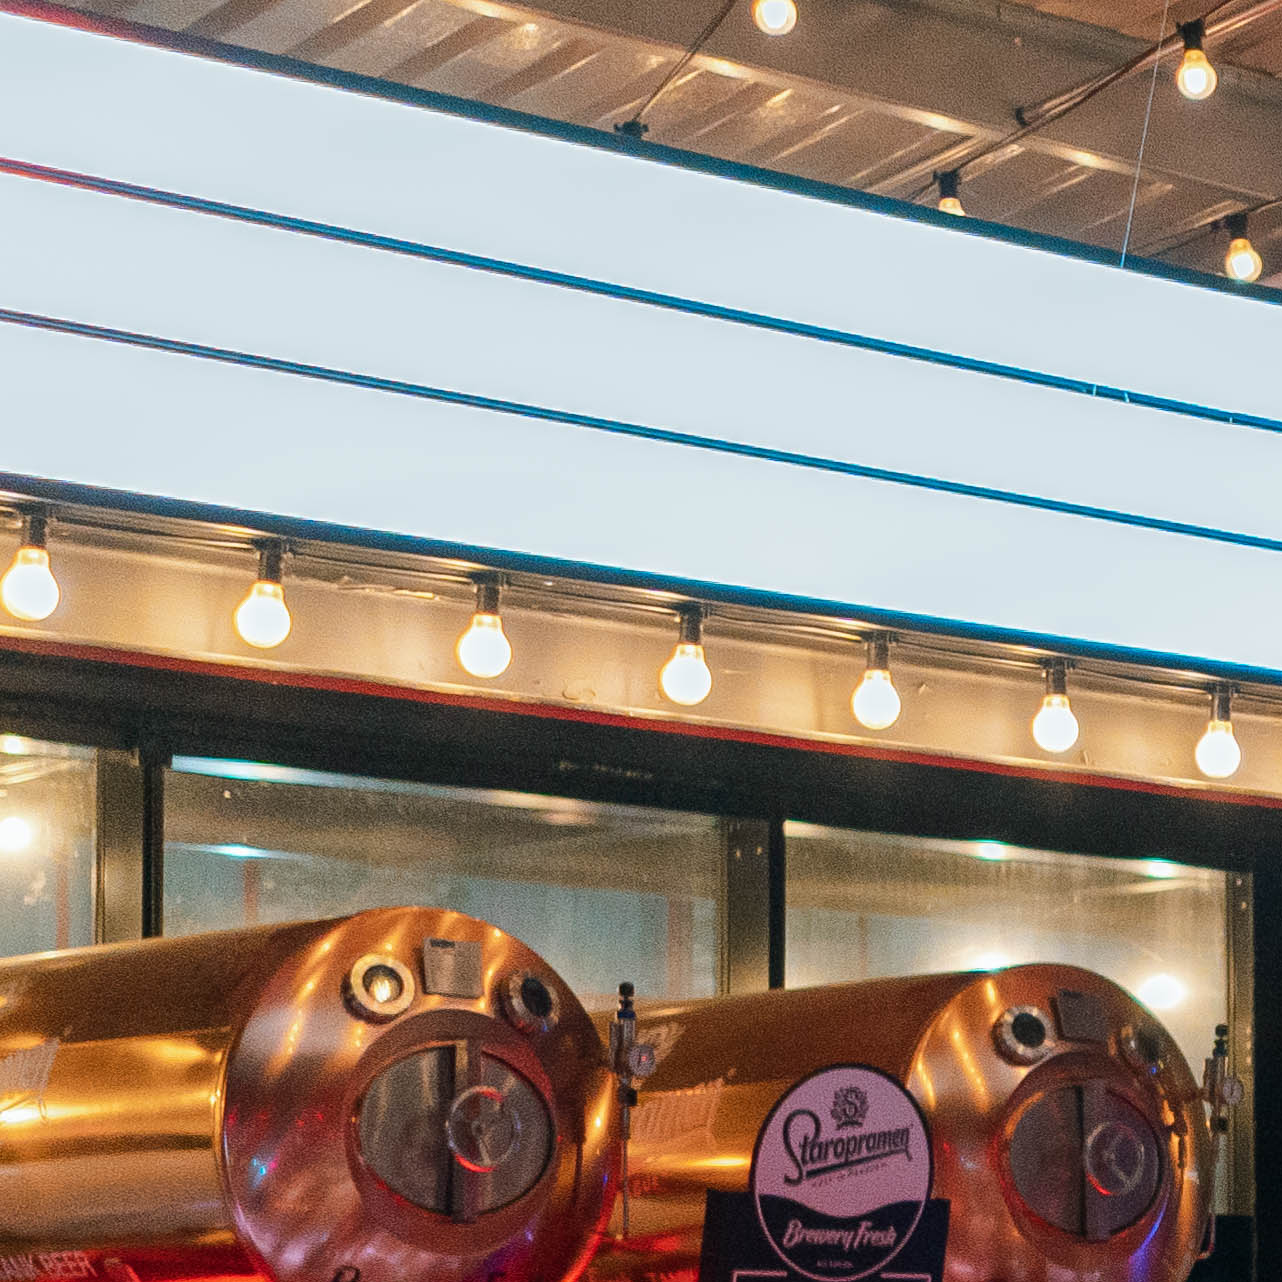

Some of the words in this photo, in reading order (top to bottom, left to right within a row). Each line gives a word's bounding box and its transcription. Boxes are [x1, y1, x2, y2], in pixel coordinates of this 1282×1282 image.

[783, 1109, 913, 1186] Staropramen
[783, 1219, 855, 1252] Brewery
[853, 1221, 897, 1249] Fresh
[0, 1253, 37, 1282] ANK
